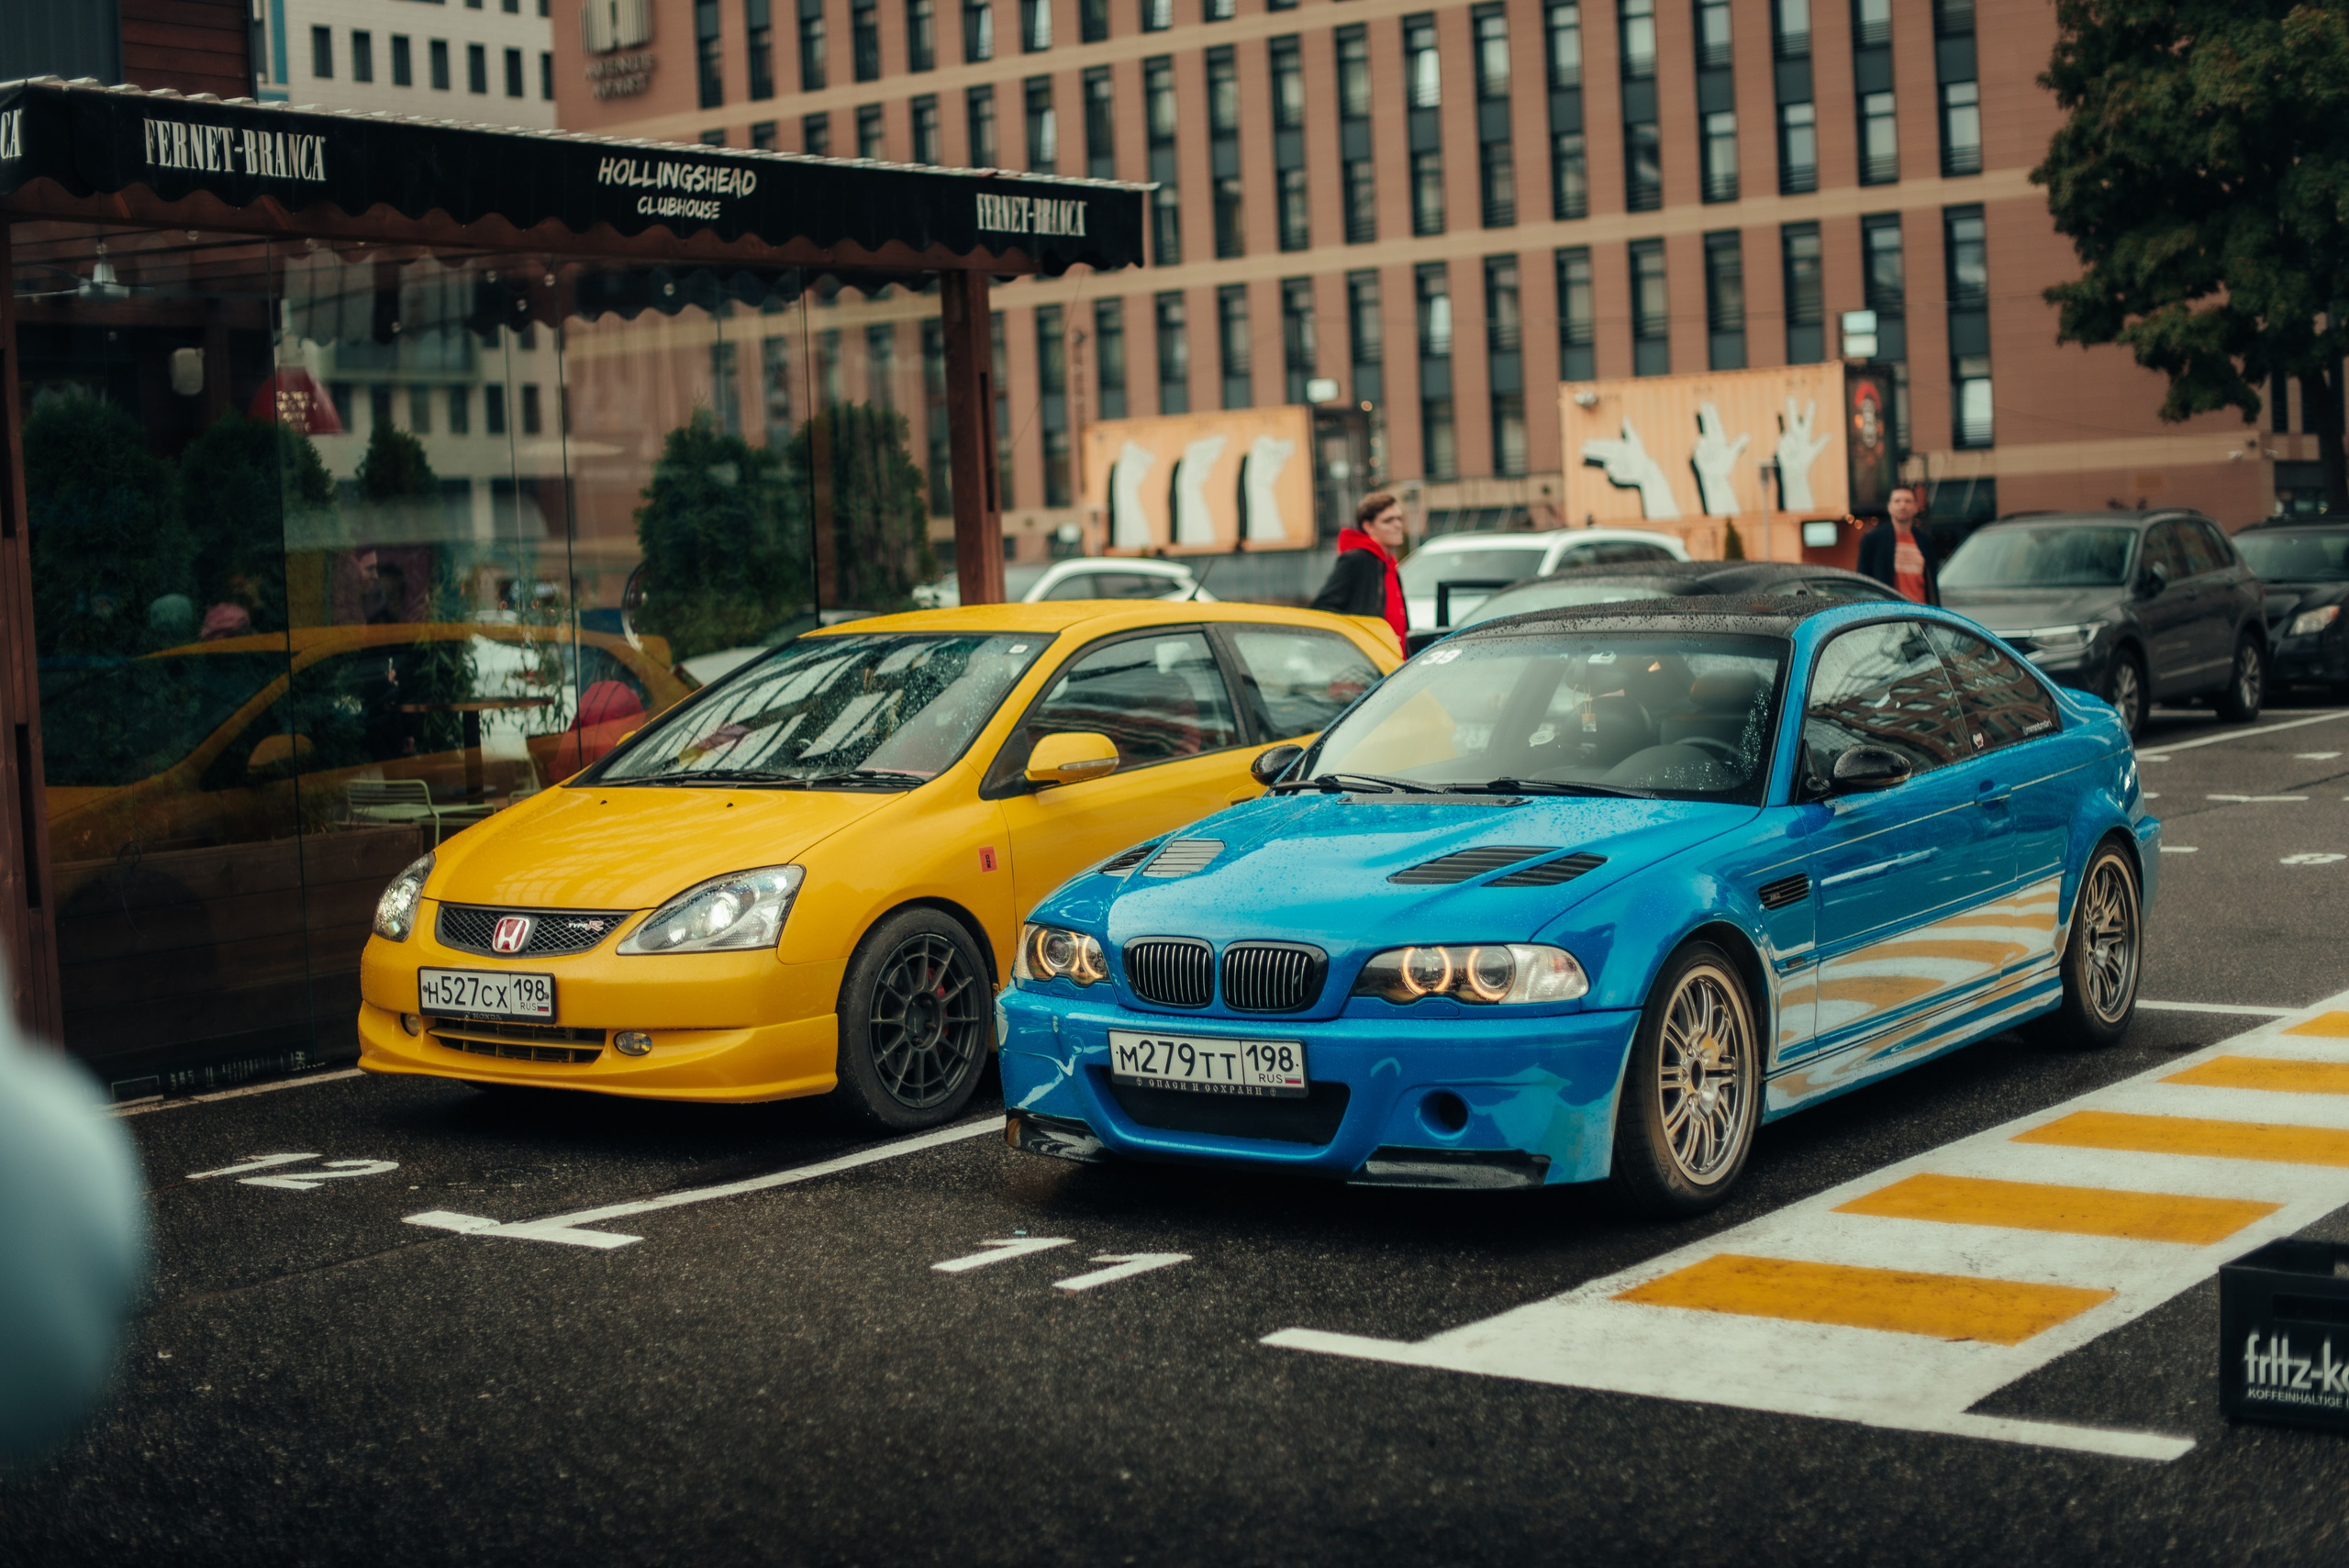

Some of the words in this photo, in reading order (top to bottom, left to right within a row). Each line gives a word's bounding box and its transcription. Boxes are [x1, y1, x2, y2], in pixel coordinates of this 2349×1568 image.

[598, 157, 757, 198] HOLLINGSHEAD
[637, 195, 721, 219] CLUBHOUSE
[513, 979, 545, 1002] 198
[473, 1012, 502, 1020] HONDA
[520, 1002, 537, 1011] RUS
[1245, 1044, 1294, 1072] 198
[1258, 1073, 1283, 1084] RUS
[2248, 1388, 2343, 1408] KOFFEINHALTIGE
